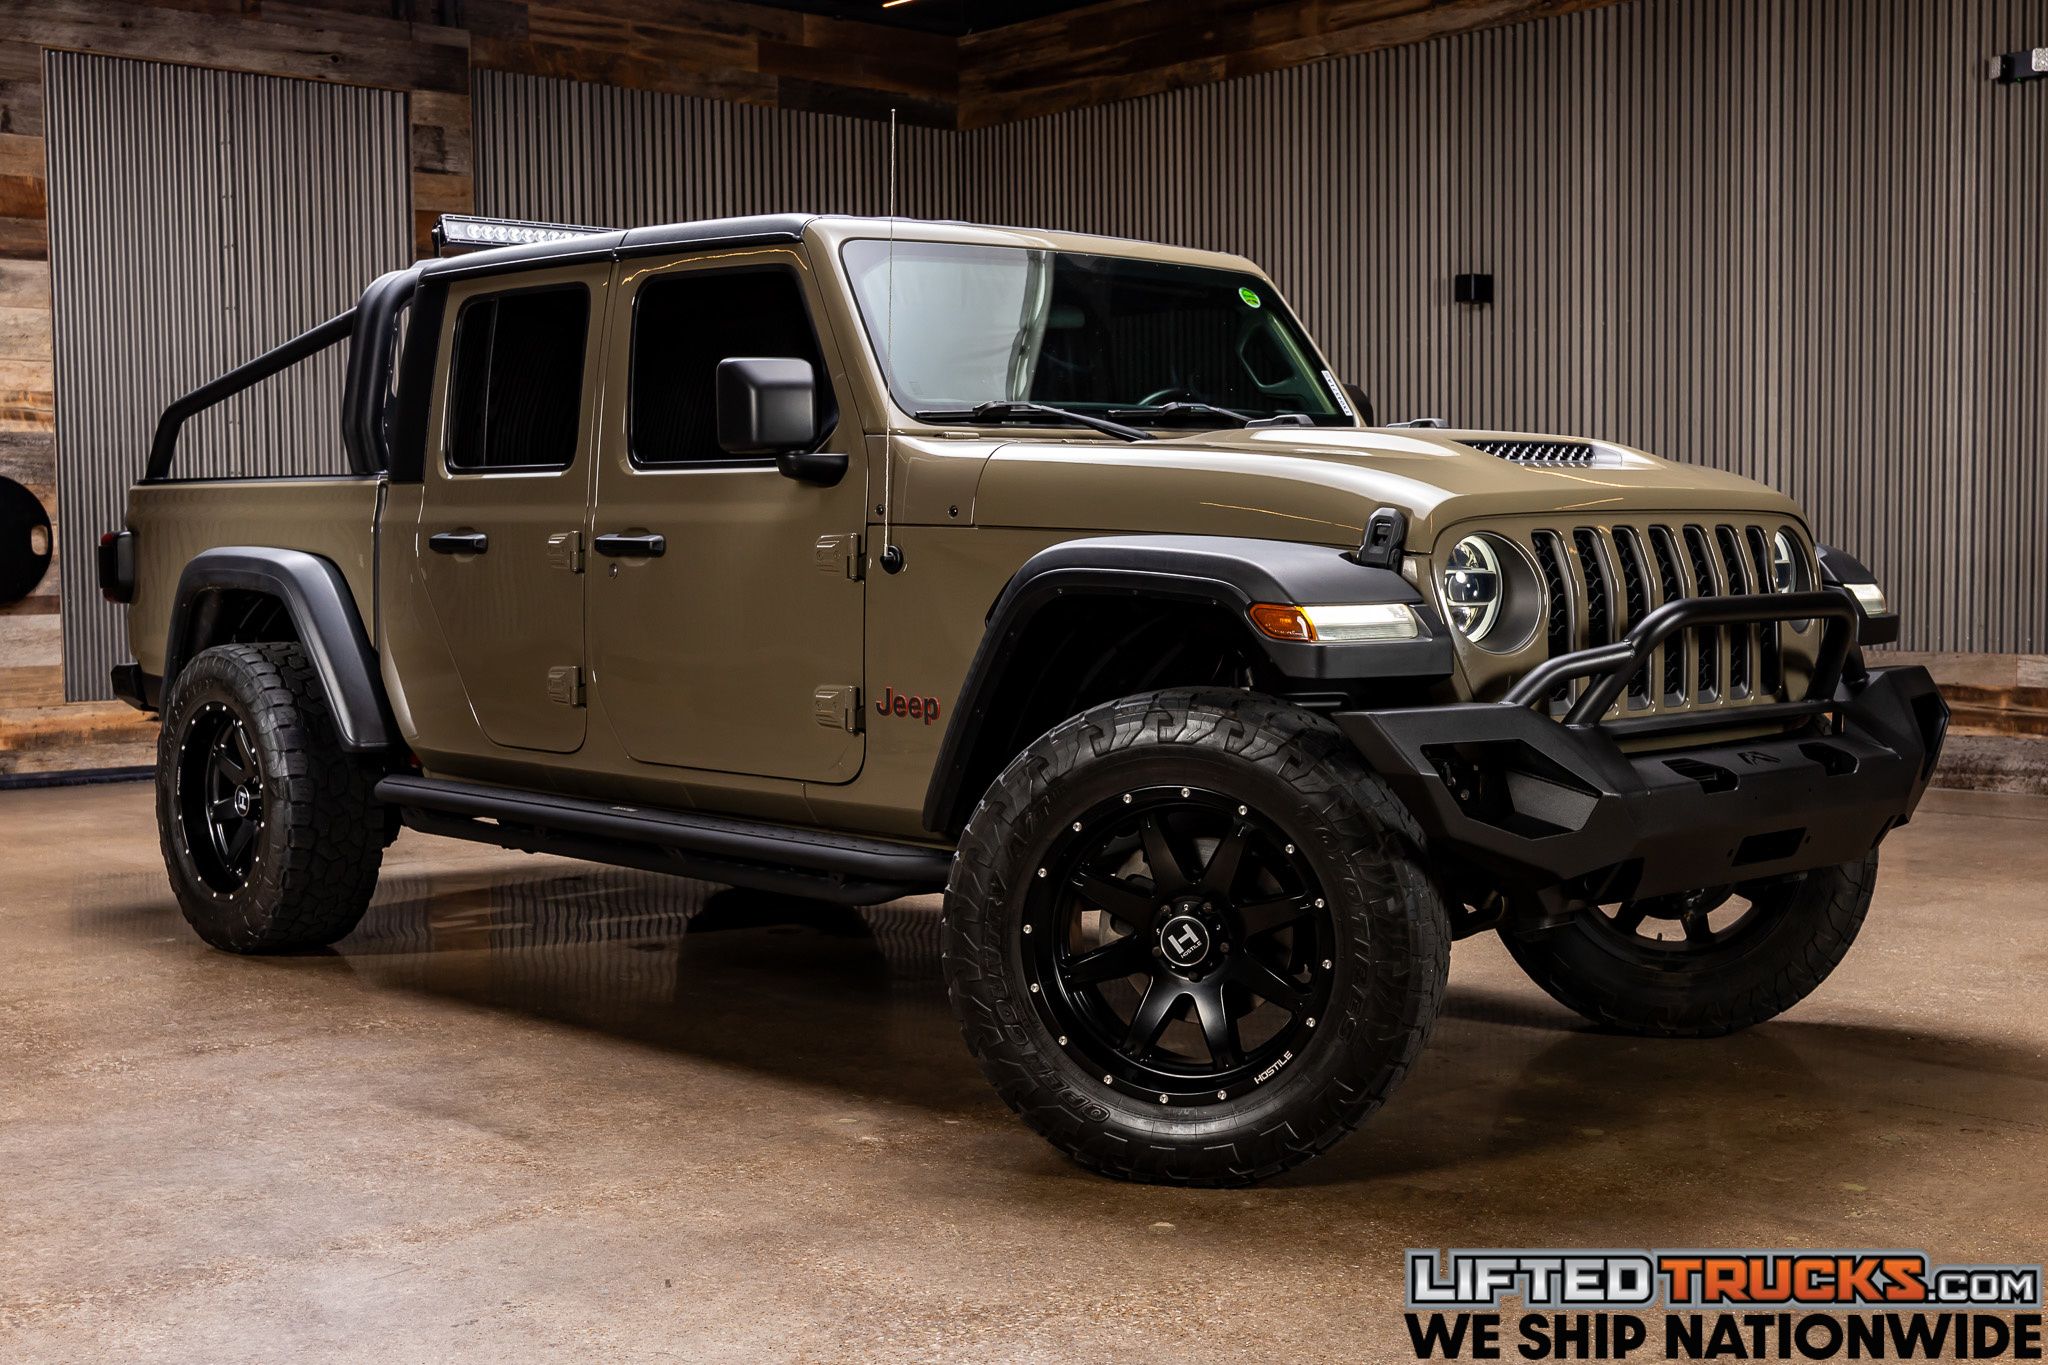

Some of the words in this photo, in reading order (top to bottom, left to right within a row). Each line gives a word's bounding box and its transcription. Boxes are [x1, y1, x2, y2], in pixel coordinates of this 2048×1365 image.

[876, 687, 940, 725] Jeep
[1168, 923, 1200, 955] H
[1253, 1050, 1293, 1085] HOSTILE
